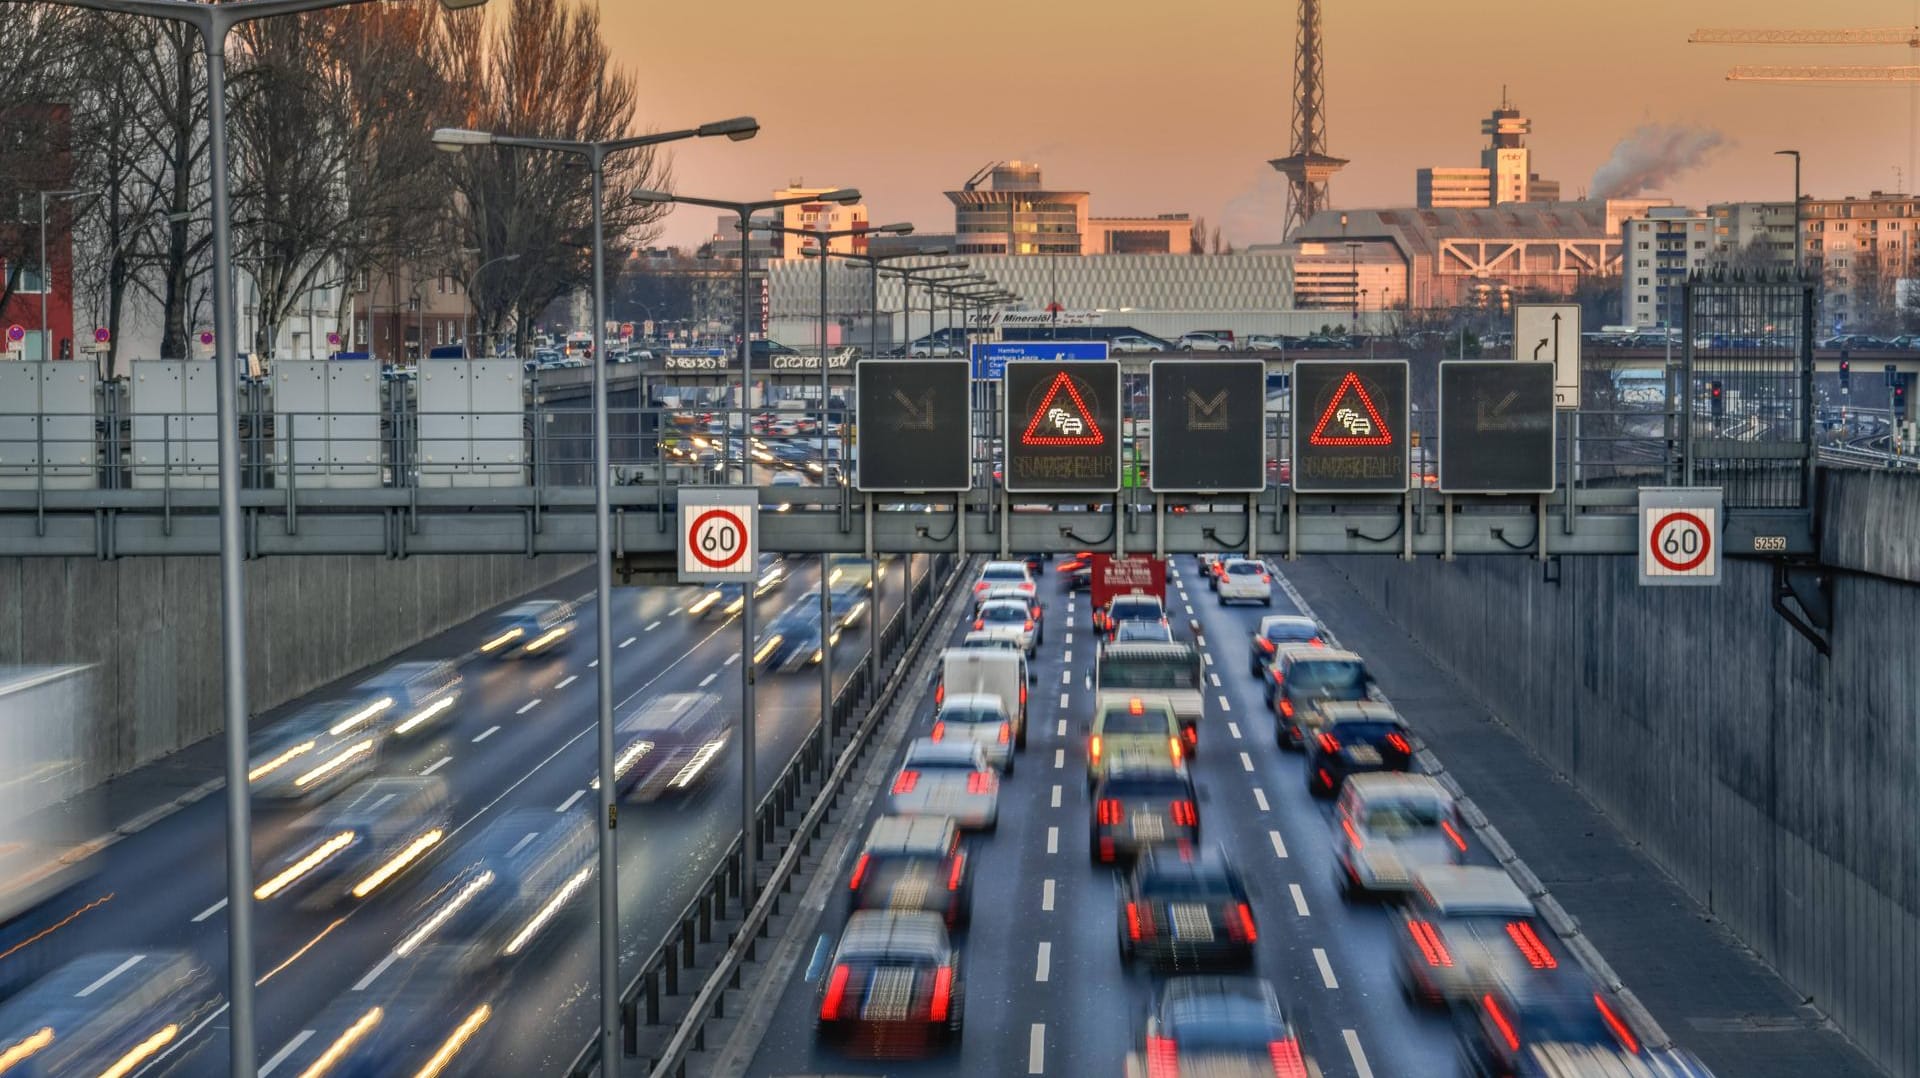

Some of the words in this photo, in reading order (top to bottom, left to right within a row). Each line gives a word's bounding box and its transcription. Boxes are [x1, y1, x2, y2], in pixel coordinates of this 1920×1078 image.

[703, 526, 734, 551] 60
[1664, 529, 1697, 554] 60
[1755, 538, 1785, 550] 52552
